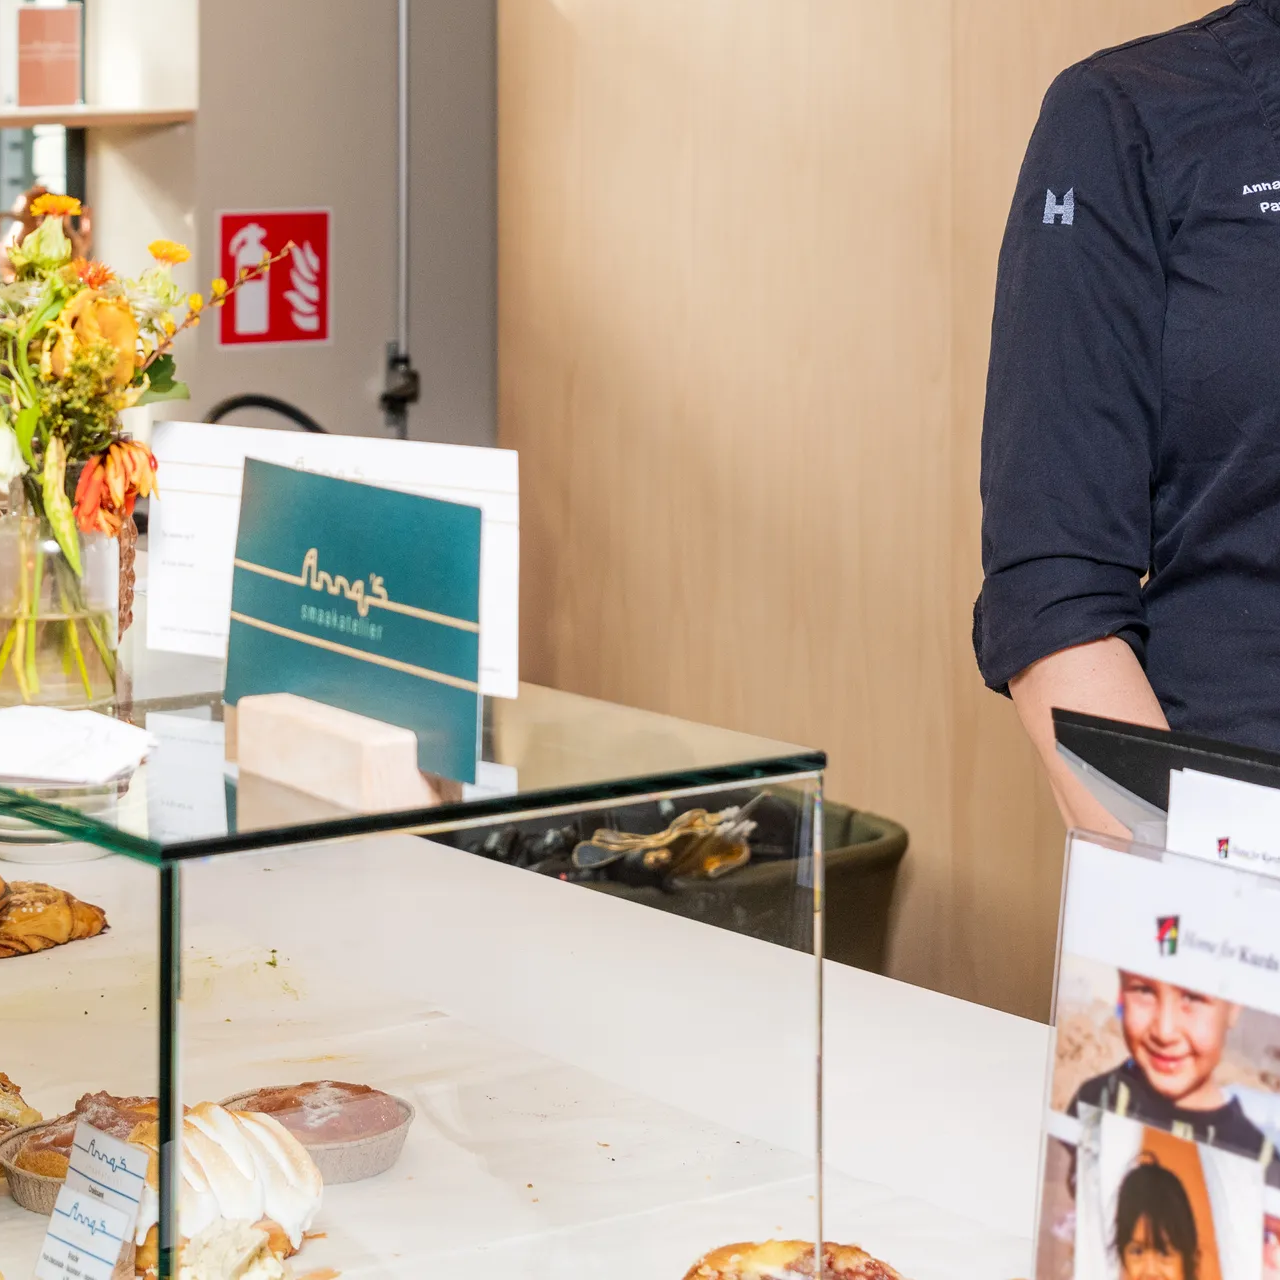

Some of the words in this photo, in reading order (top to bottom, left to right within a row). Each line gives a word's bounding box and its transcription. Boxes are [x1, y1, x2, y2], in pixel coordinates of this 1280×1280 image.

[301, 546, 389, 618] Anna's
[1183, 929, 1217, 955] Home
[1216, 938, 1237, 960] for
[1238, 942, 1280, 972] Kurds
[87, 1137, 128, 1174] Anna's
